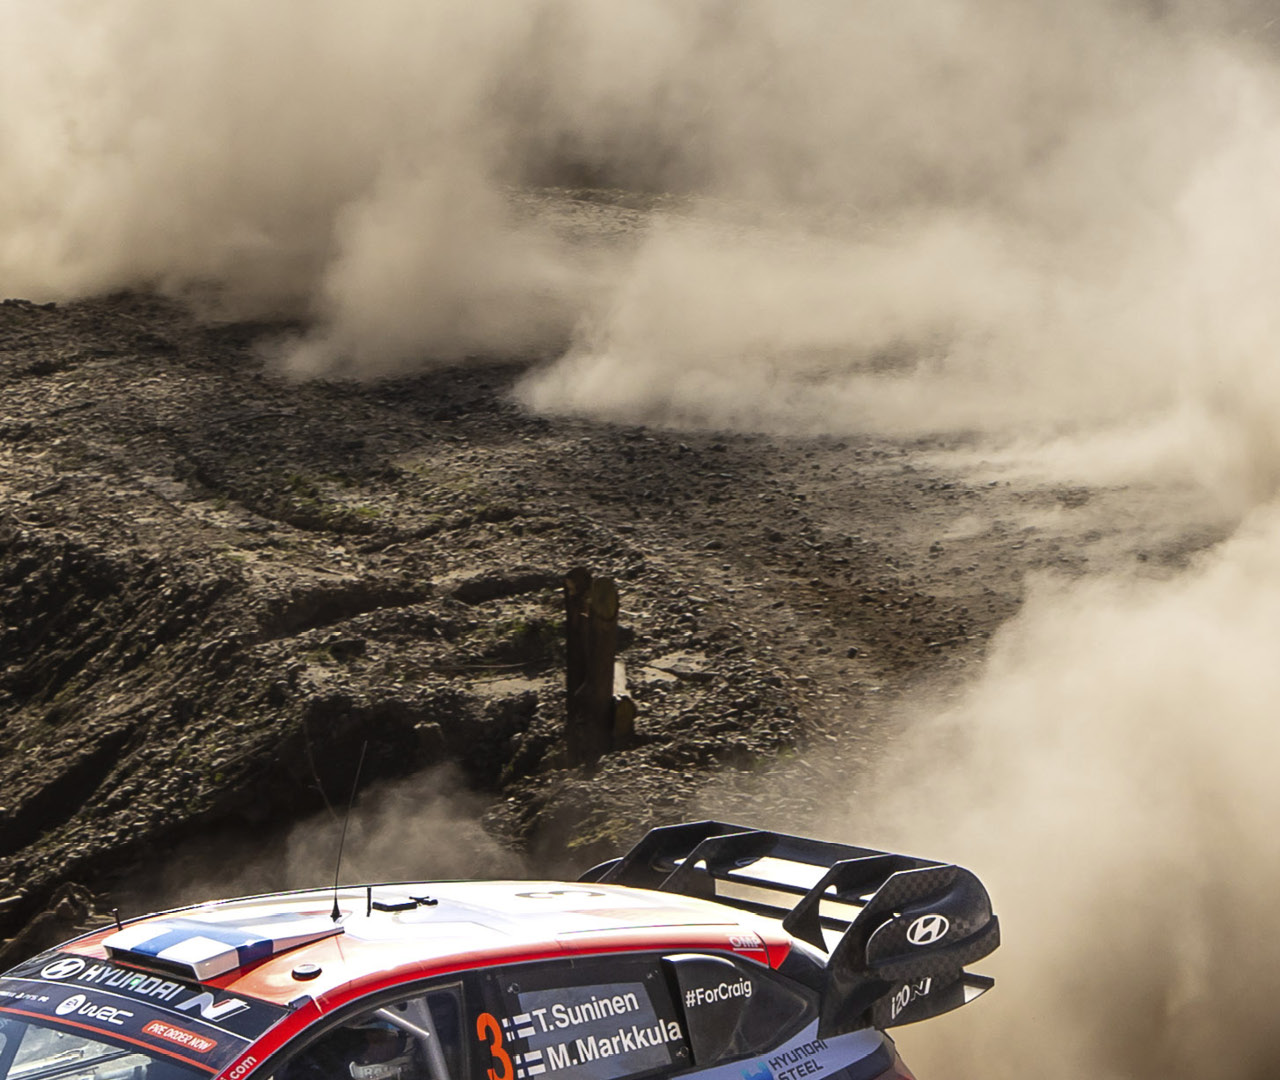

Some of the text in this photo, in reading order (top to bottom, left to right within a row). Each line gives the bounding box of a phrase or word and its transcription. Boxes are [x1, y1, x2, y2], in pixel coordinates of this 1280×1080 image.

[729, 936, 762, 949] OMP
[77, 965, 186, 1001] HYUNDAI
[685, 977, 753, 1008] #ForCraig
[78, 1001, 134, 1025] WRC
[532, 992, 640, 1034] T.Suninen
[147, 1023, 213, 1050] PRE ORDER NOW
[546, 1019, 683, 1072] M.Markkula
[768, 1039, 828, 1071] HYUNDAI
